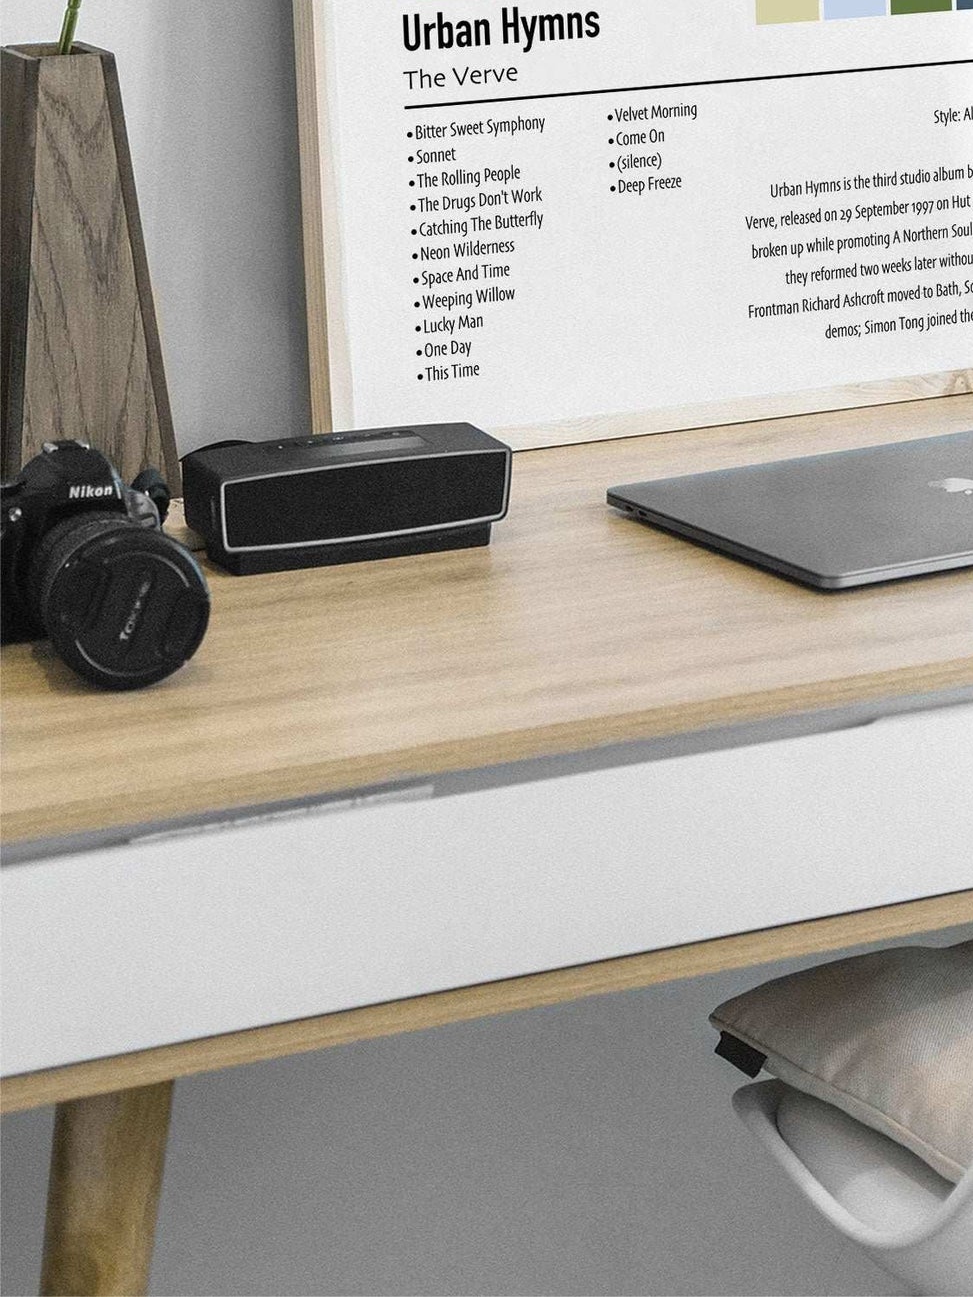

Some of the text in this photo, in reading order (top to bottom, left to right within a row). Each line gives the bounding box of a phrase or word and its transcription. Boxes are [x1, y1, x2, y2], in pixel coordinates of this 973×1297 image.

[402, 6, 600, 53] Urban Hymns
[402, 66, 518, 90] The Verve
[614, 102, 697, 122] Velvet Morning
[933, 107, 960, 127] Style:
[415, 115, 545, 140] Bitter Sweet Symphony
[615, 128, 665, 146] Come On
[416, 147, 456, 164] Sonnet
[617, 151, 662, 173] (silence)
[416, 164, 520, 188] The Rolling People
[618, 176, 682, 195] Deep Freeze
[770, 181, 802, 198] Urban
[805, 180, 841, 197] Hymns
[843, 176, 851, 190] is
[853, 174, 870, 189] the
[872, 170, 897, 187] third
[899, 168, 931, 185] studio
[932, 166, 964, 182] album
[417, 185, 542, 213] The Drugs Don't Work
[419, 210, 543, 237] Catching The Butterfly
[744, 215, 777, 230] Verve,
[780, 207, 821, 226] released
[824, 209, 837, 222] on
[839, 208, 852, 223] 29
[854, 200, 909, 222] September
[911, 200, 934, 215] 1997
[936, 198, 949, 210] on
[951, 194, 971, 209] Hut
[420, 239, 515, 261] Neon Wilderness
[751, 241, 787, 259] broken
[790, 243, 804, 258] up
[805, 236, 834, 253] while
[836, 231, 890, 254] promoting
[892, 230, 901, 244] A
[903, 225, 948, 242] Northern
[951, 221, 972, 238] Soul
[421, 263, 510, 289] Space And Time
[784, 269, 808, 287] they
[810, 262, 857, 282] reformed
[859, 263, 879, 276] two
[881, 257, 912, 274] weeks
[914, 255, 937, 270] later
[422, 286, 515, 311] Weeping Willow
[748, 302, 799, 318] Frontman
[802, 293, 840, 312] Richard
[842, 288, 885, 308] Ashcroft
[887, 284, 920, 303] moved
[922, 286, 933, 298] to
[936, 280, 962, 297] Bath,
[423, 314, 483, 335] Lucky Man
[824, 324, 861, 339] demos;
[864, 319, 896, 334] Simon
[898, 316, 924, 332] Tong
[925, 309, 957, 331] joined
[424, 340, 472, 357] One Day
[424, 363, 479, 381] This Time
[69, 485, 113, 499] Nikon
